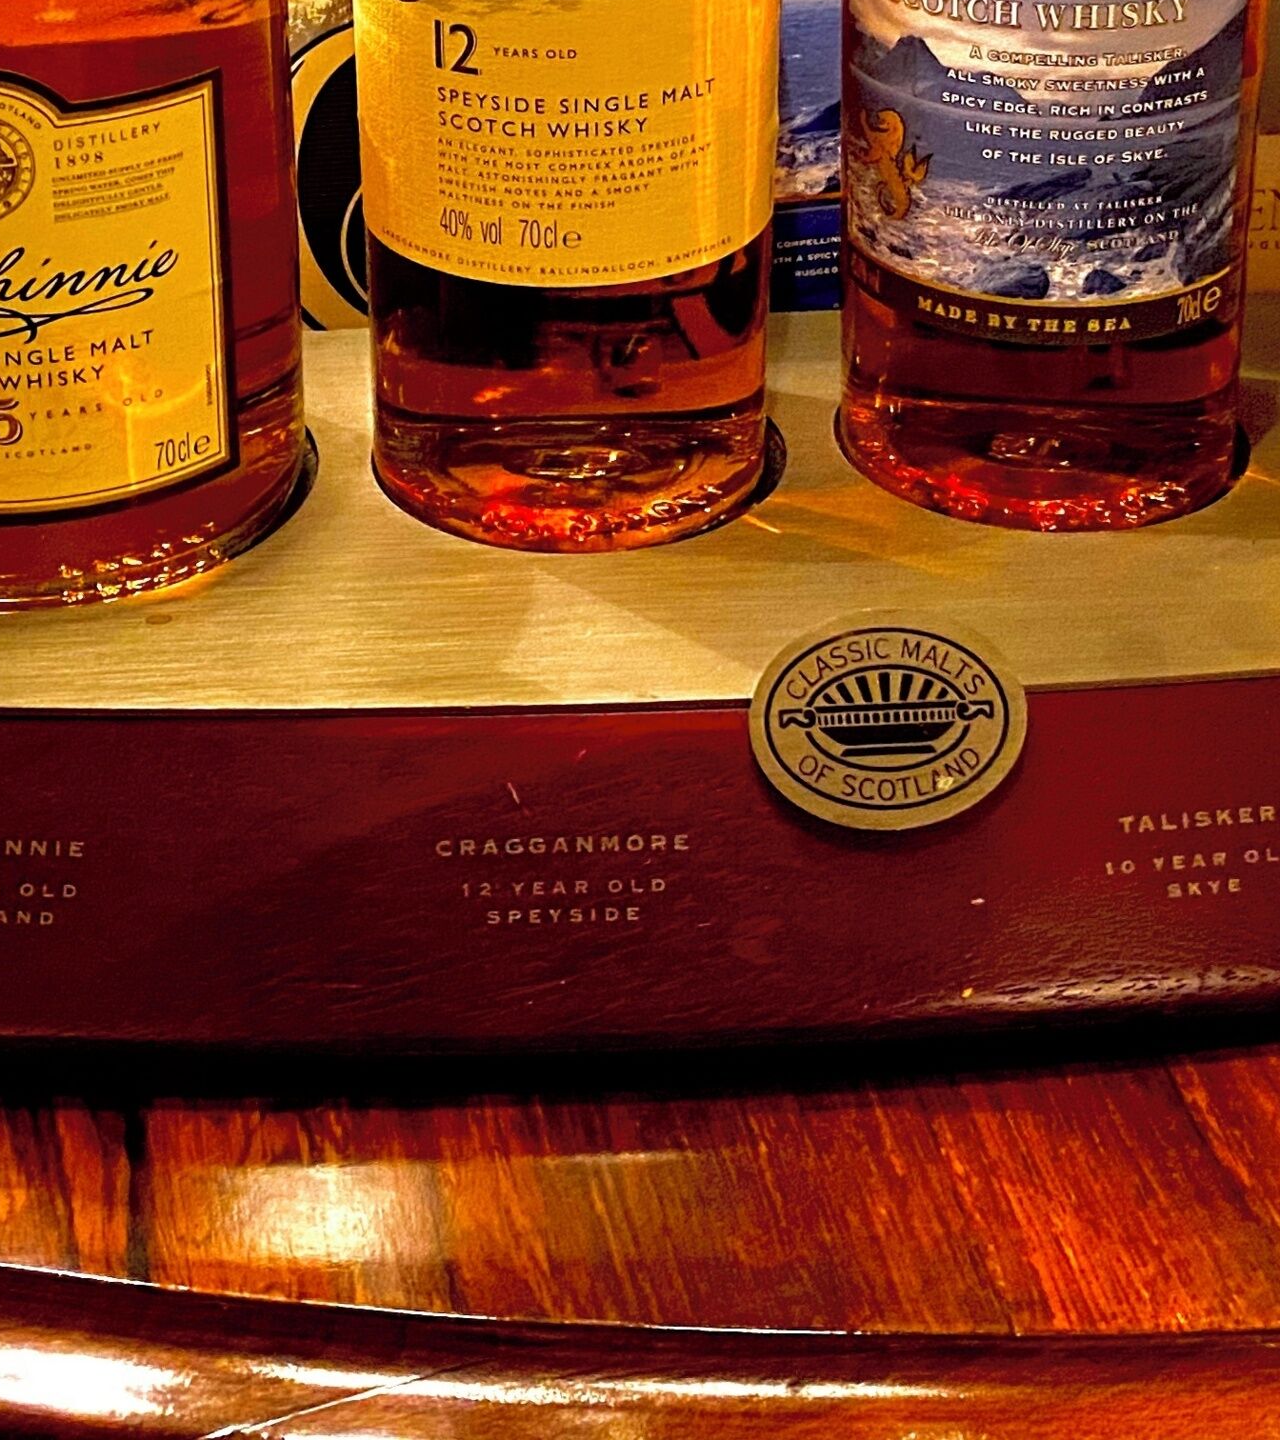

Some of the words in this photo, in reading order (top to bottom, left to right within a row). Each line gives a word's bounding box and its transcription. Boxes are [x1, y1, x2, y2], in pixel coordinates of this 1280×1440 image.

[433, 19, 482, 77] 12
[492, 46, 539, 60] YEARS
[545, 48, 578, 60] OLD
[970, 46, 982, 60] A
[988, 47, 1097, 67] COMPELLING
[947, 68, 976, 83] ALL
[982, 74, 1039, 91] SMOKY
[1044, 77, 1148, 92] SWEETNESS
[1153, 71, 1192, 87] WITH
[1195, 67, 1206, 78] A
[437, 86, 547, 115] SPEYSIDE
[560, 92, 649, 114] SINGLE
[662, 78, 716, 105] MALT
[942, 92, 986, 109] SPICY
[1050, 103, 1090, 116] RICH
[1097, 103, 1115, 115] IN
[1121, 91, 1208, 115] CONTRASTS
[53, 122, 160, 151] DISTILLERY
[438, 111, 536, 138] SCOTCH
[549, 117, 648, 139] WHISKY
[966, 121, 1002, 136] LIKE
[1008, 126, 1042, 140] THE
[1049, 128, 1118, 141] RUGGED
[1124, 119, 1185, 139] BEAUTY
[54, 151, 104, 169] 1898
[982, 148, 1003, 160] OF
[1008, 151, 1042, 164] THE
[1050, 152, 1088, 165] ISLE
[1094, 153, 1115, 164] OF
[439, 207, 473, 241] 40%
[480, 220, 502, 246] vol
[519, 218, 558, 249] 70cl
[918, 296, 977, 323] MADE
[988, 313, 1017, 329] BY
[1027, 317, 1076, 332] THE
[1087, 318, 1131, 331] SEA
[90, 329, 155, 356] MALT
[30, 403, 103, 421] YEARS
[122, 388, 163, 407] OLD
[155, 433, 191, 470] 70cl
[786, 638, 890, 701] CLASSIC
[901, 638, 986, 696] MALTS
[798, 755, 835, 784] OF
[841, 747, 981, 801] SCOTLAND
[1119, 805, 1276, 834] TALISKER
[435, 834, 690, 857] CRAGGANMORE
[1105, 860, 1136, 876] 10
[1153, 852, 1227, 872] YEAR
[20, 883, 77, 897] OLD
[462, 883, 492, 898] 12
[511, 880, 589, 895] YEAR
[608, 878, 667, 894] OLD
[1167, 878, 1241, 898] SKYE
[487, 907, 640, 925] SPEYSIDE
